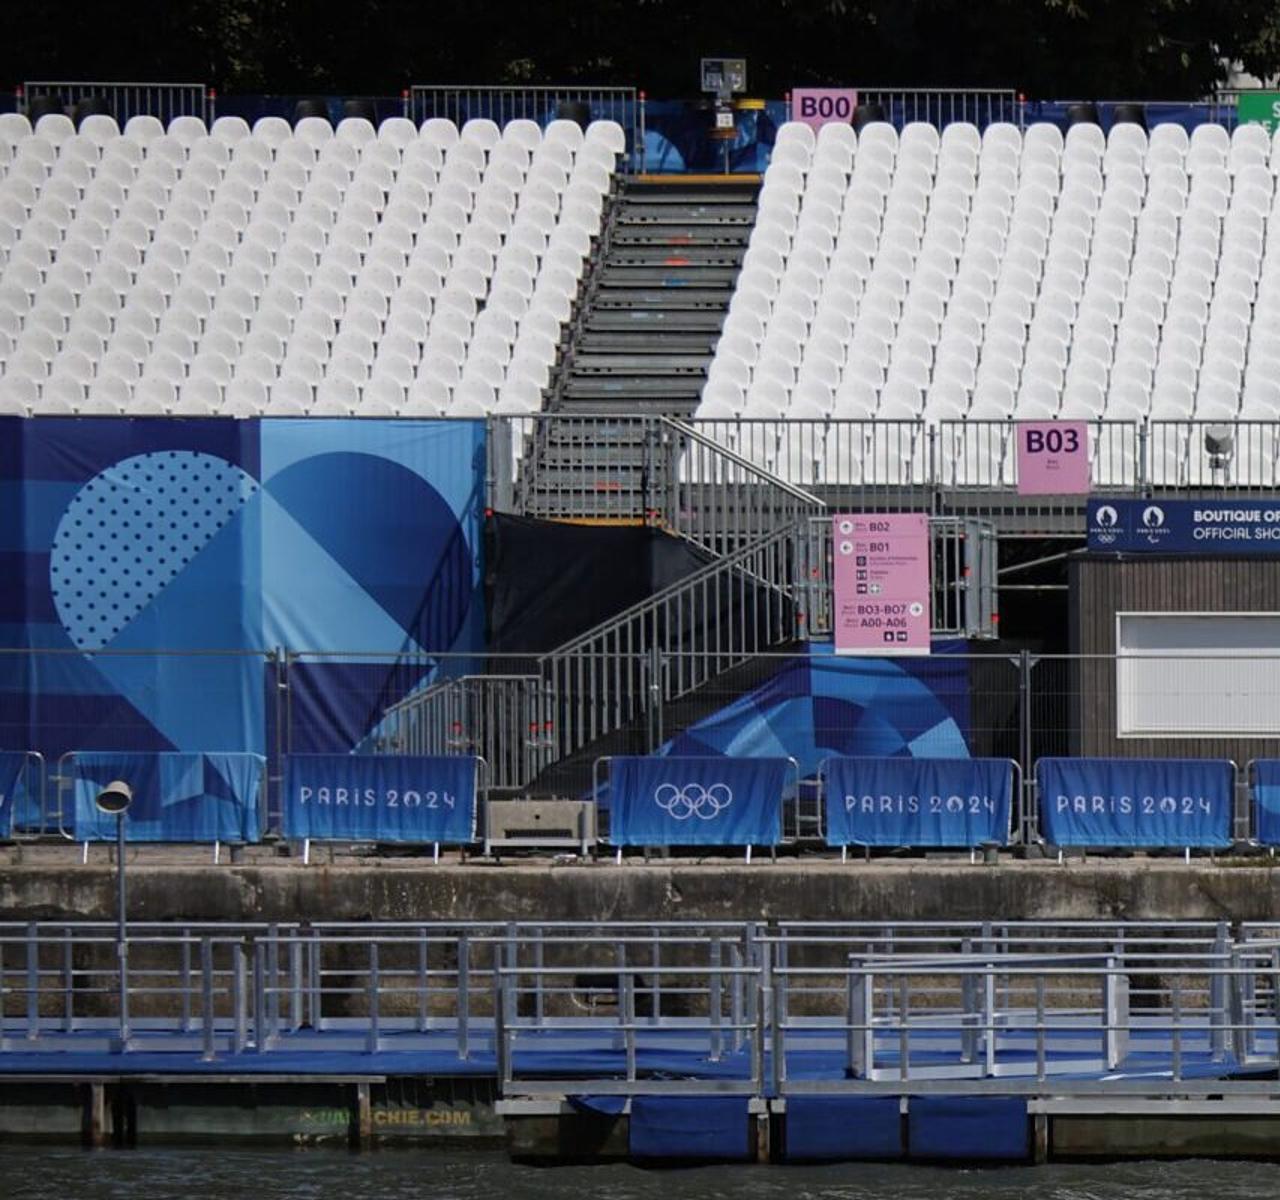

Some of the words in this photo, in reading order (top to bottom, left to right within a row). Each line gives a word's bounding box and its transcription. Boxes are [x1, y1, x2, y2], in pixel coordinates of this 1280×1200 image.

[800, 95, 851, 119] B00
[1026, 428, 1079, 454] B03
[1193, 509, 1261, 523] BOUTIQUE
[869, 522, 890, 532] B02
[1193, 527, 1251, 540] OFFICIAL
[869, 542, 890, 553] B01
[857, 604, 907, 615] B03-B07
[860, 618, 907, 628] A00-A06
[386, 789, 455, 809] 2024
[929, 795, 995, 815] 2024
[1143, 796, 1211, 815] 2024
